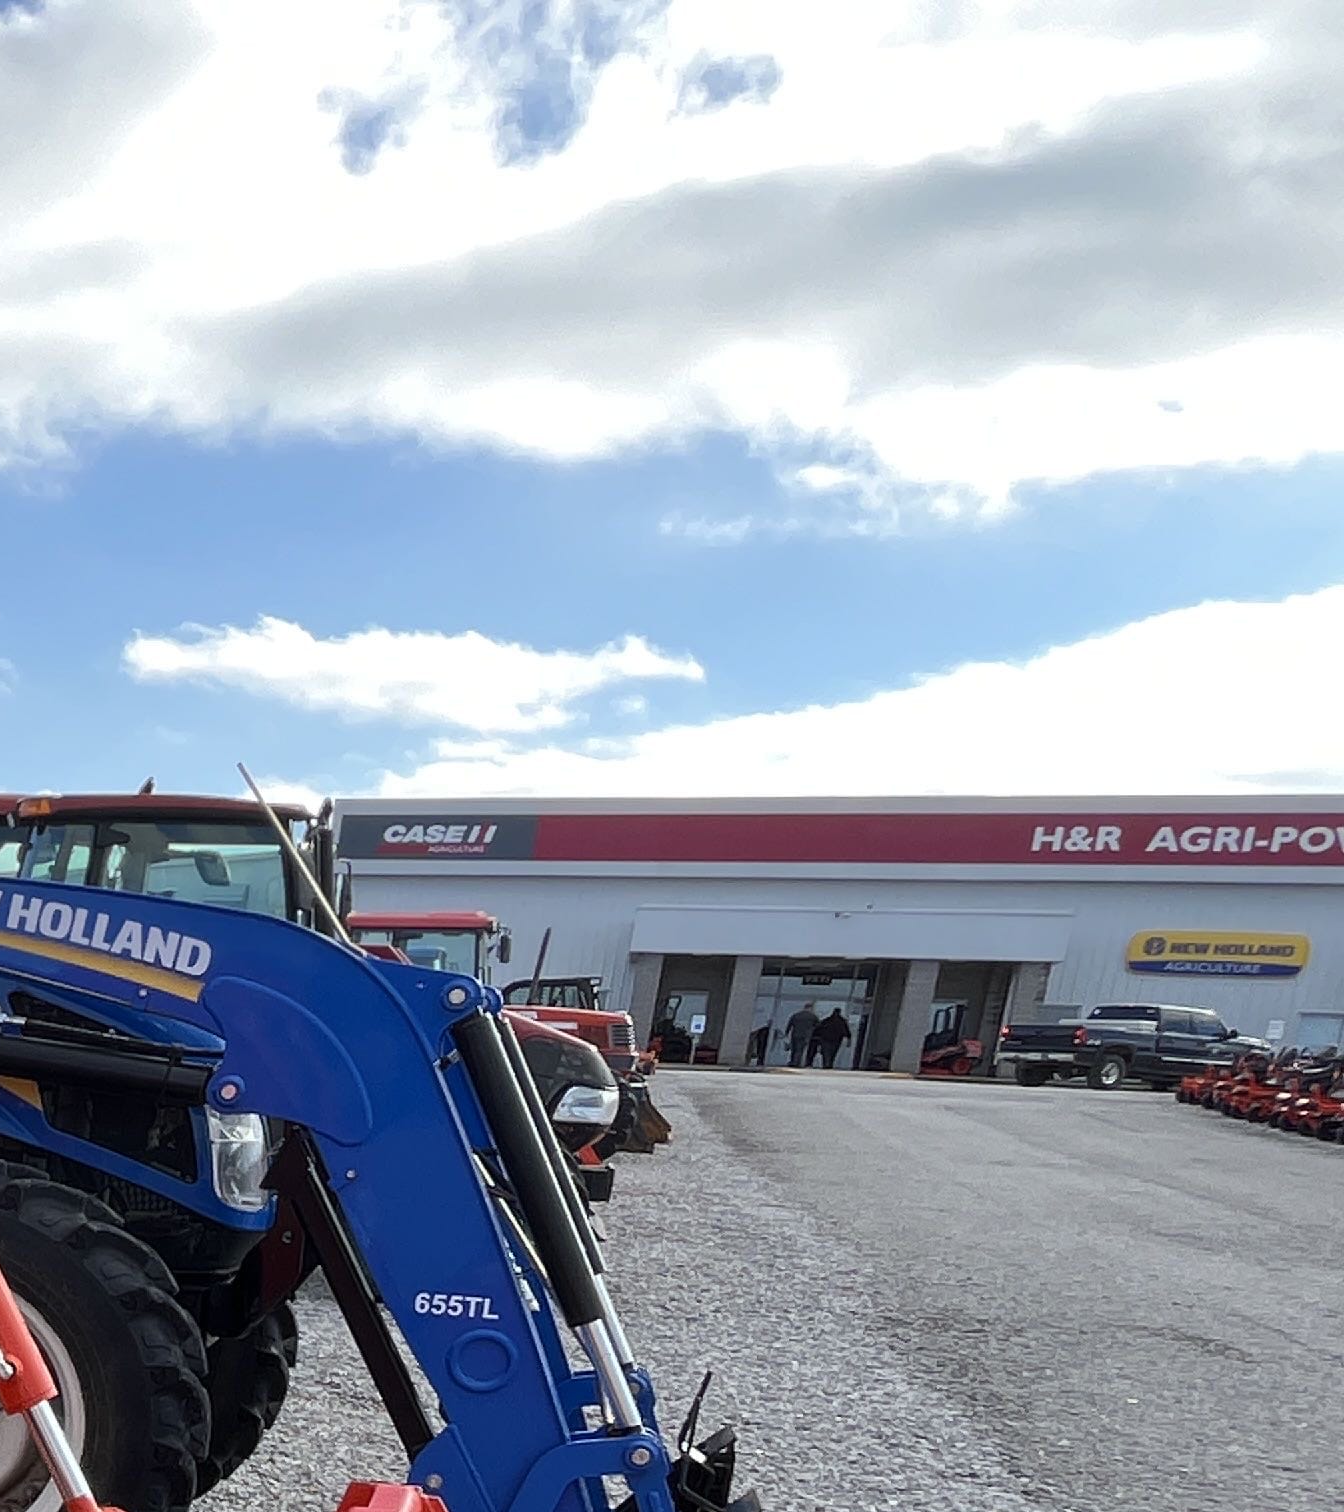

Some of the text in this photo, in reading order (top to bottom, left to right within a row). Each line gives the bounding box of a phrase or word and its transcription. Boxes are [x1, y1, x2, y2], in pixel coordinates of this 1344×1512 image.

[1031, 826, 1122, 852] H&R
[6, 893, 212, 977] HOLLAND
[1169, 942, 1296, 957] NEW HOLLAND
[1162, 961, 1262, 974] AGRICULTURE
[414, 1292, 500, 1320] 655TL
